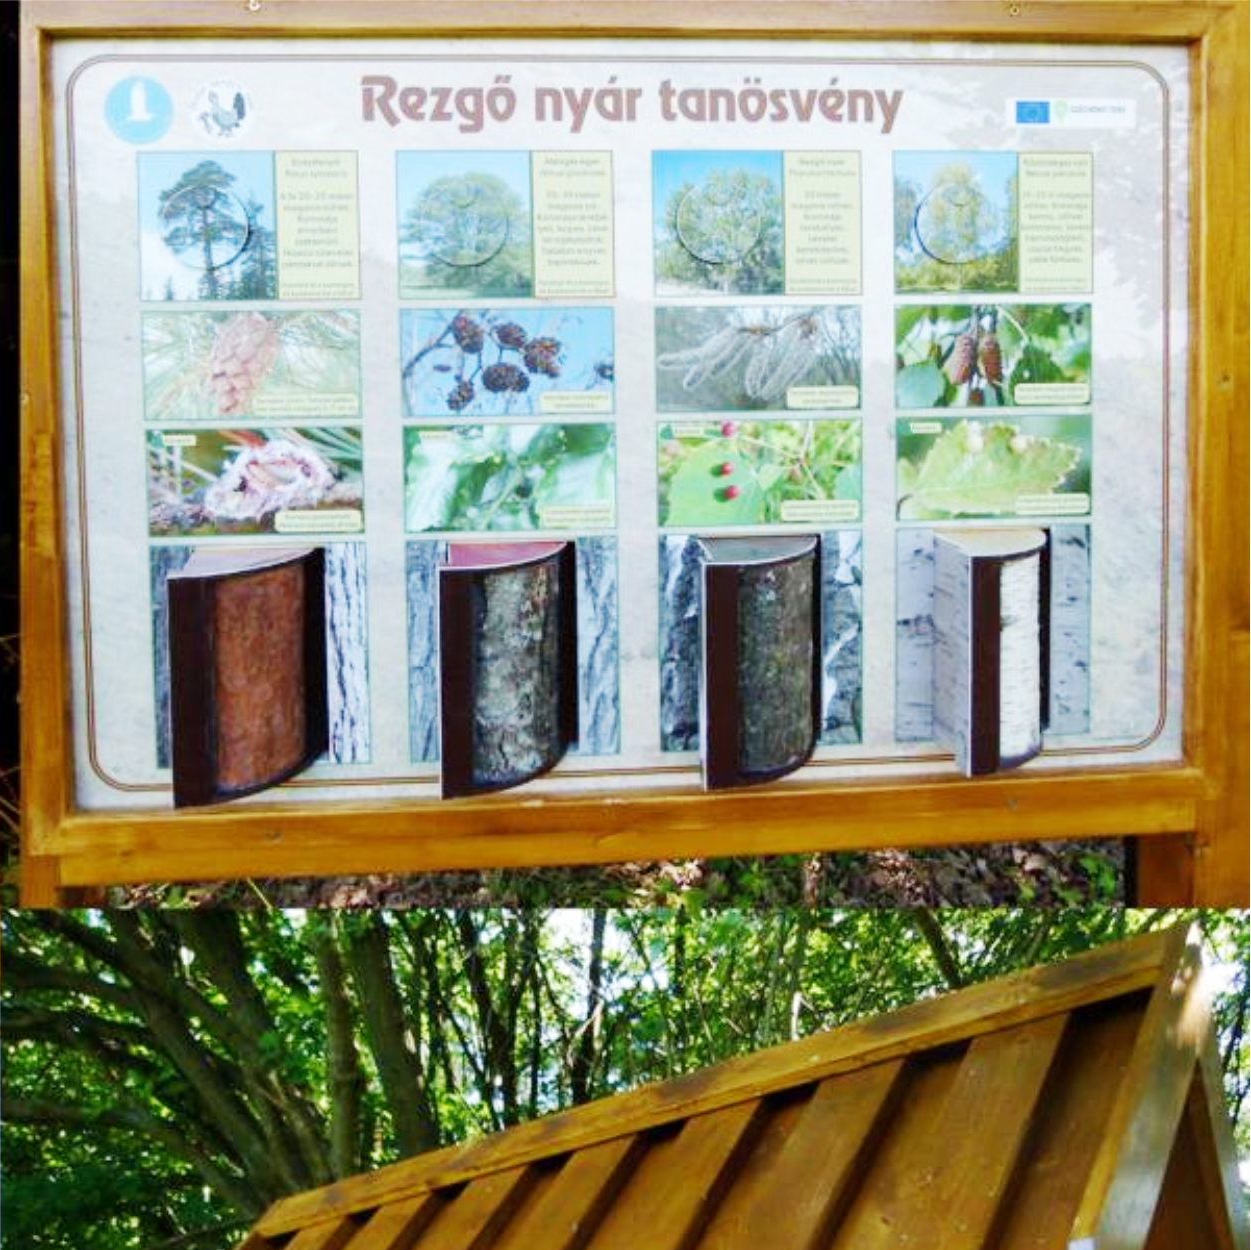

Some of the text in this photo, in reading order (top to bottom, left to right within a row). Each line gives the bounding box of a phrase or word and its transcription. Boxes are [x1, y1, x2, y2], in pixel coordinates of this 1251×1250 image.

[361, 74, 904, 135] Rezgő nyár tanösvény
